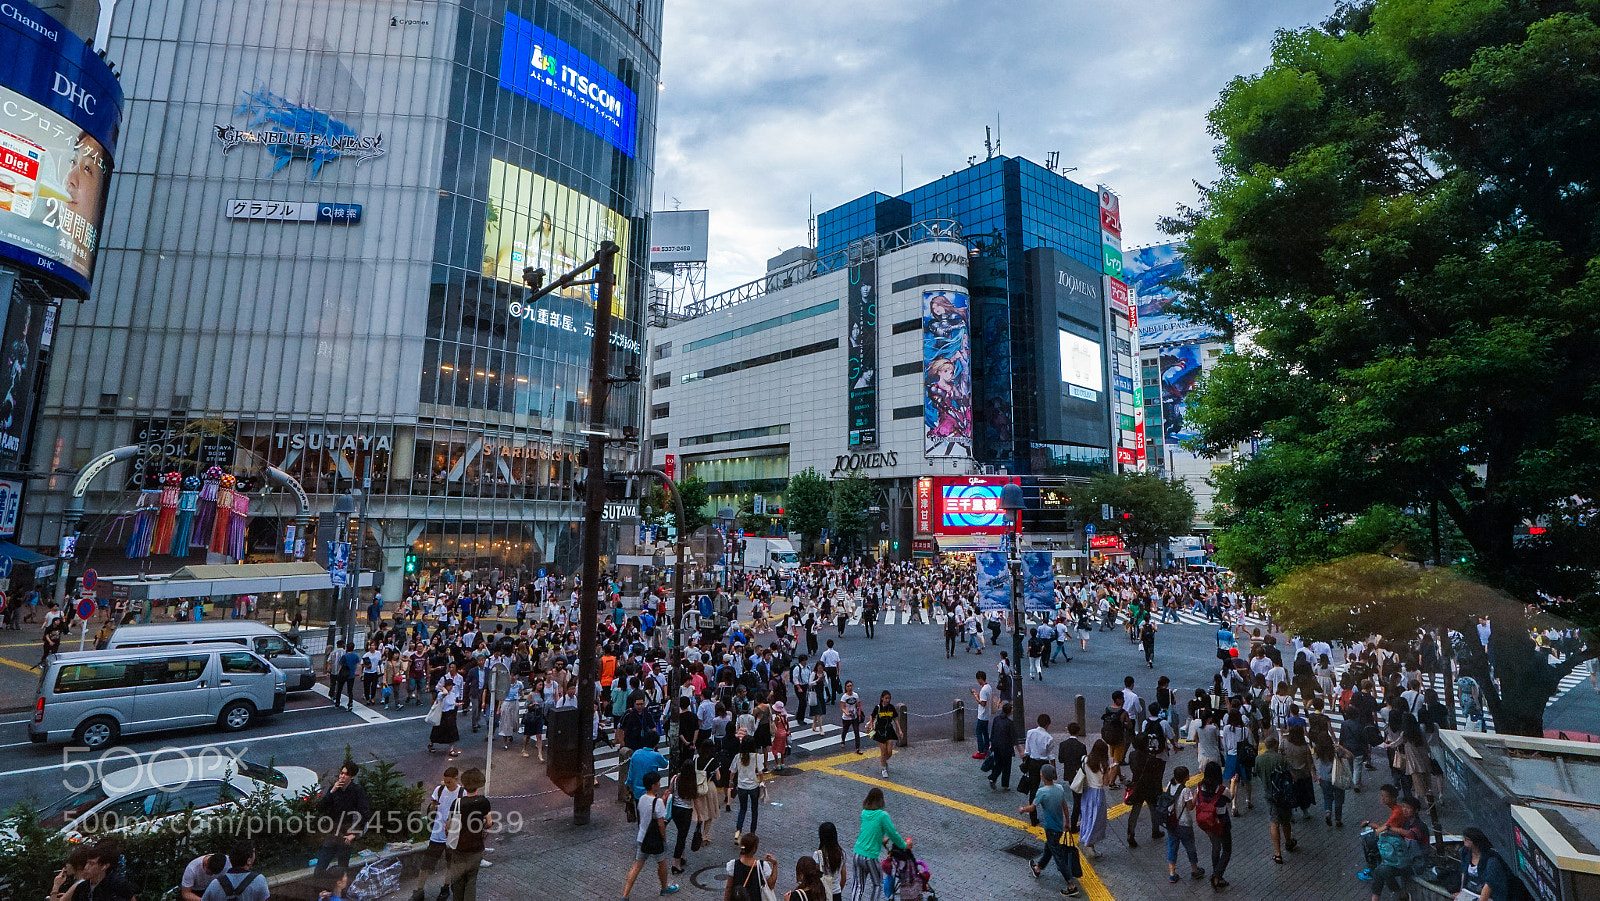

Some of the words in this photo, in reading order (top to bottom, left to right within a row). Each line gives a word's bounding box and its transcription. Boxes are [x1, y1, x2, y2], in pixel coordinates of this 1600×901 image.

[1, 3, 58, 42] Channel
[52, 71, 97, 116] DHC
[219, 128, 306, 148] GRANBLUE
[310, 131, 384, 149] FANTASY
[5, 153, 29, 172] Diet
[233, 203, 294, 217] グラブル
[333, 207, 358, 219] 検索
[37, 257, 55, 270] DHC
[1106, 253, 1121, 271] レイク
[1057, 270, 1097, 299] 109MEN'S
[275, 433, 391, 451] TSUTAYA
[1118, 450, 1131, 459] アコム
[601, 504, 636, 520] SUTAYA
[946, 498, 998, 511] 三千里薬
